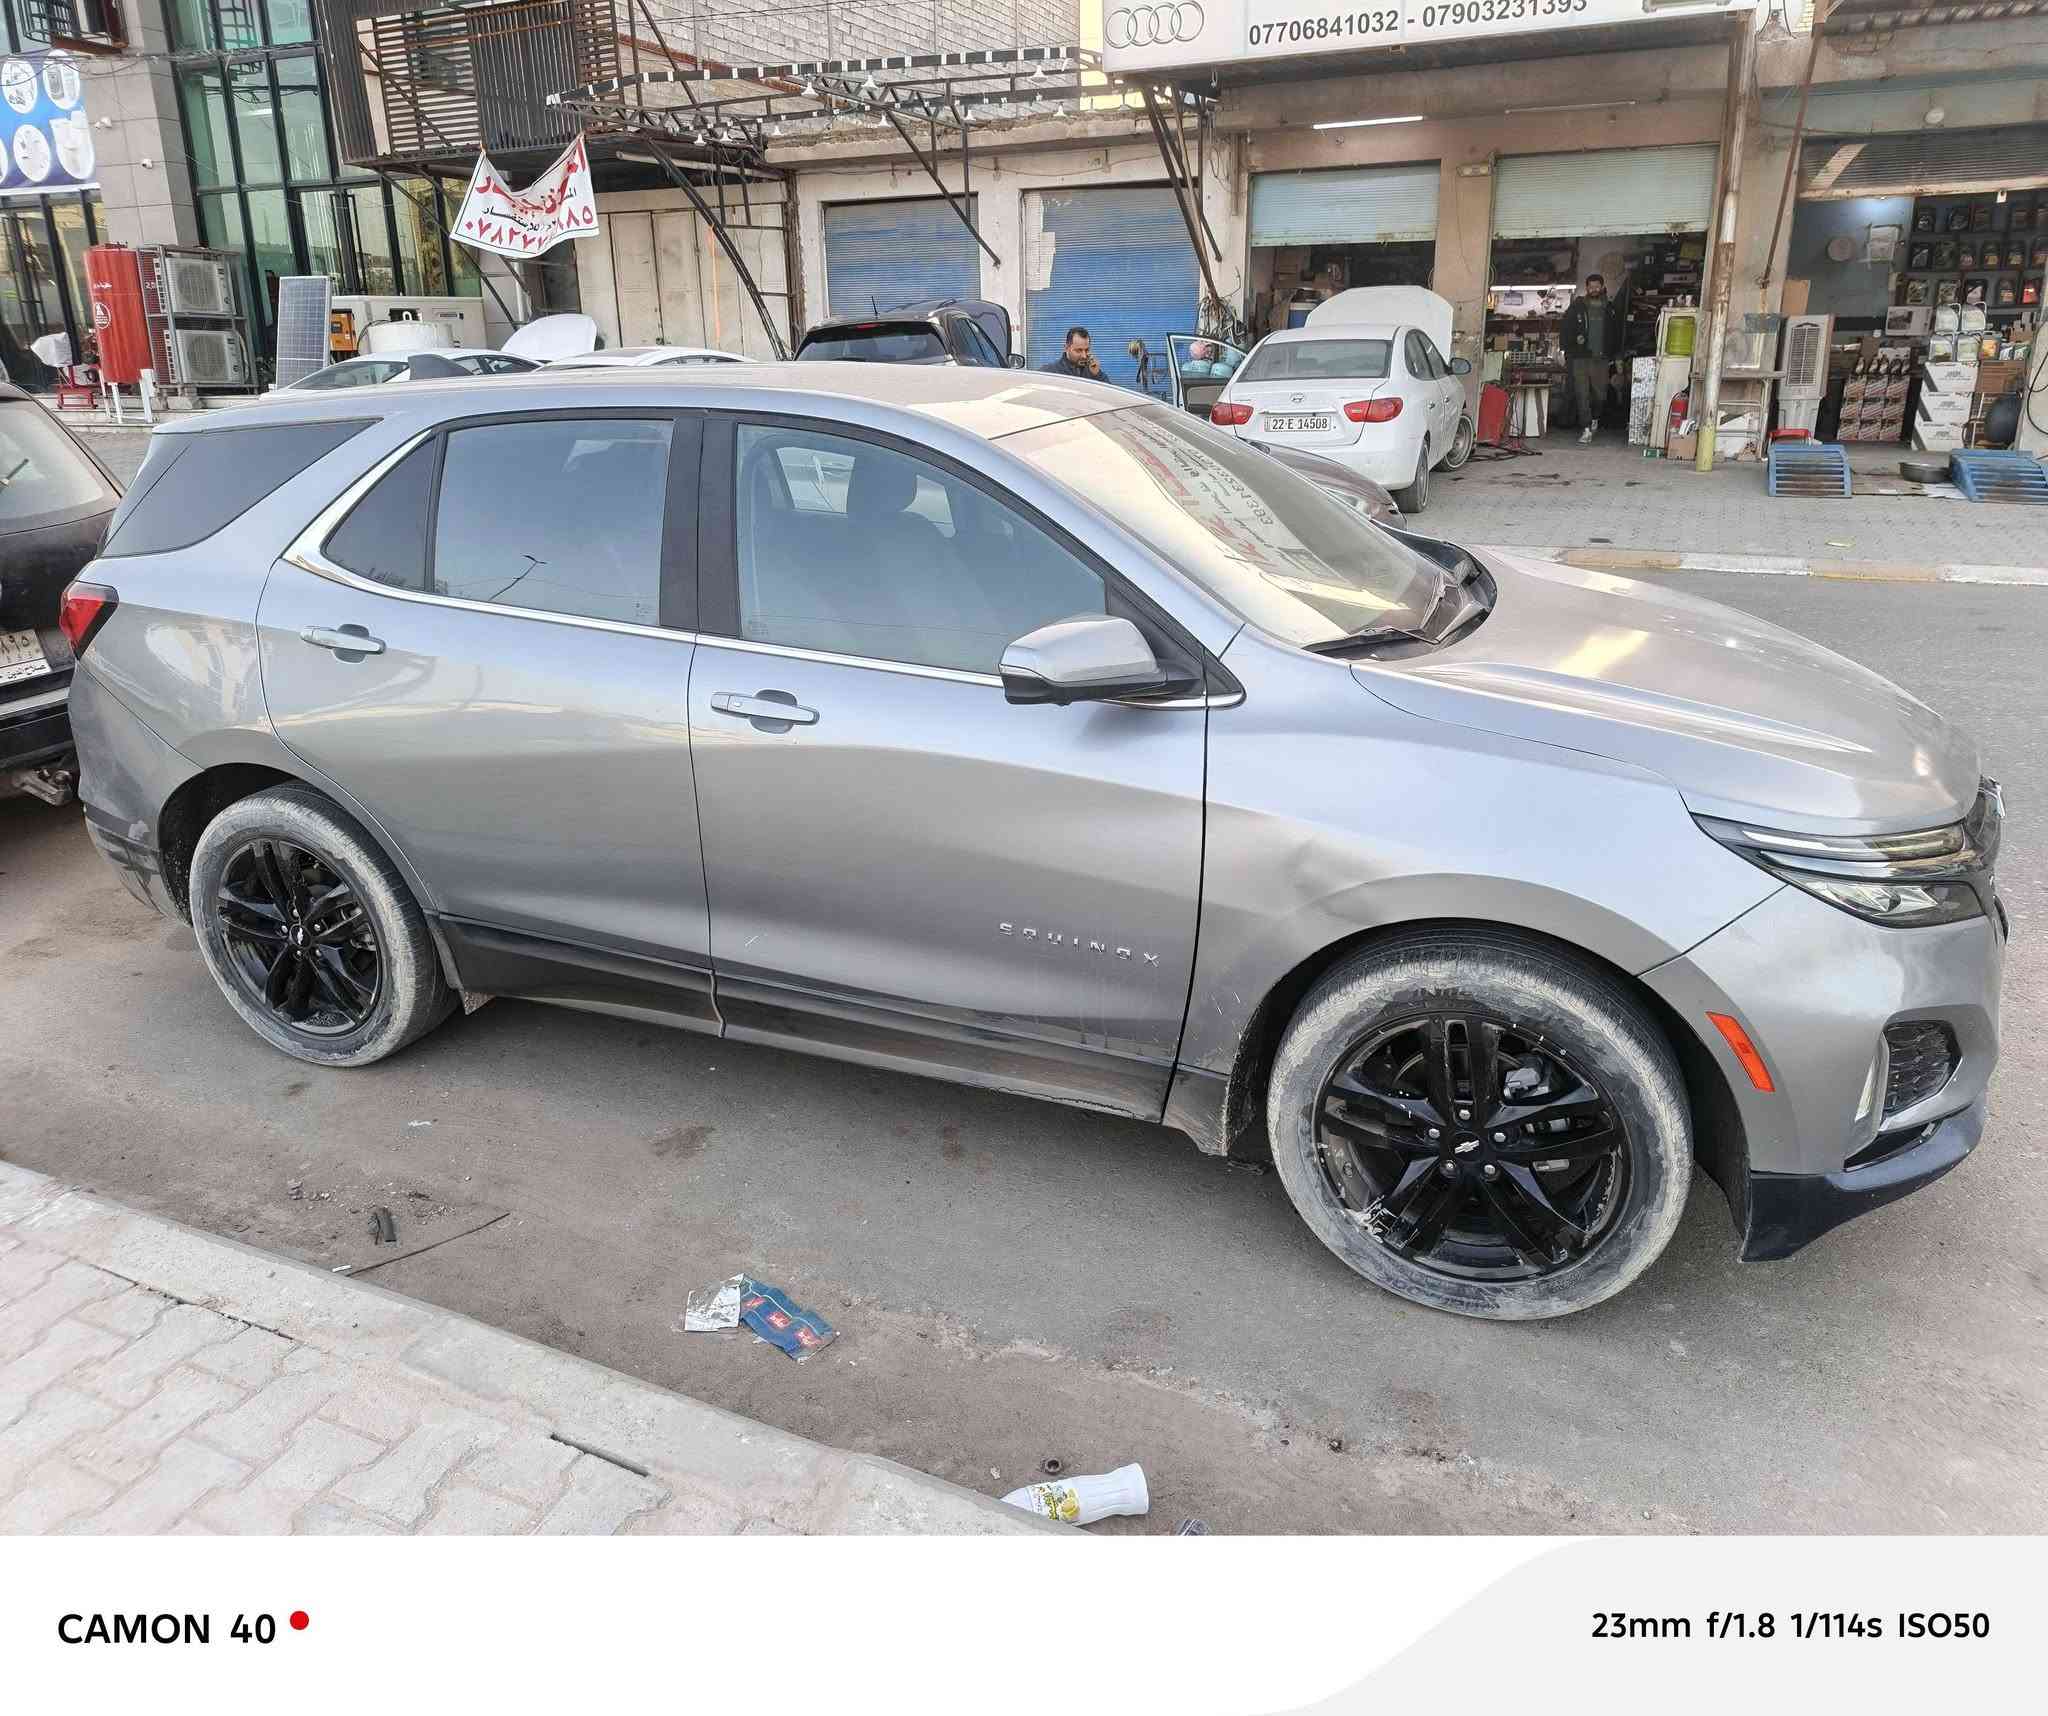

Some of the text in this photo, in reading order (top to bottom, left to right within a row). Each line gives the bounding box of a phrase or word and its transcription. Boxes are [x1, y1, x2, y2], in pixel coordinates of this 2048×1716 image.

[1249, 10, 1399, 46] 07706841032
[1272, 417, 1328, 430] 22 E 14508
[999, 922, 1161, 968] EQUINOX
